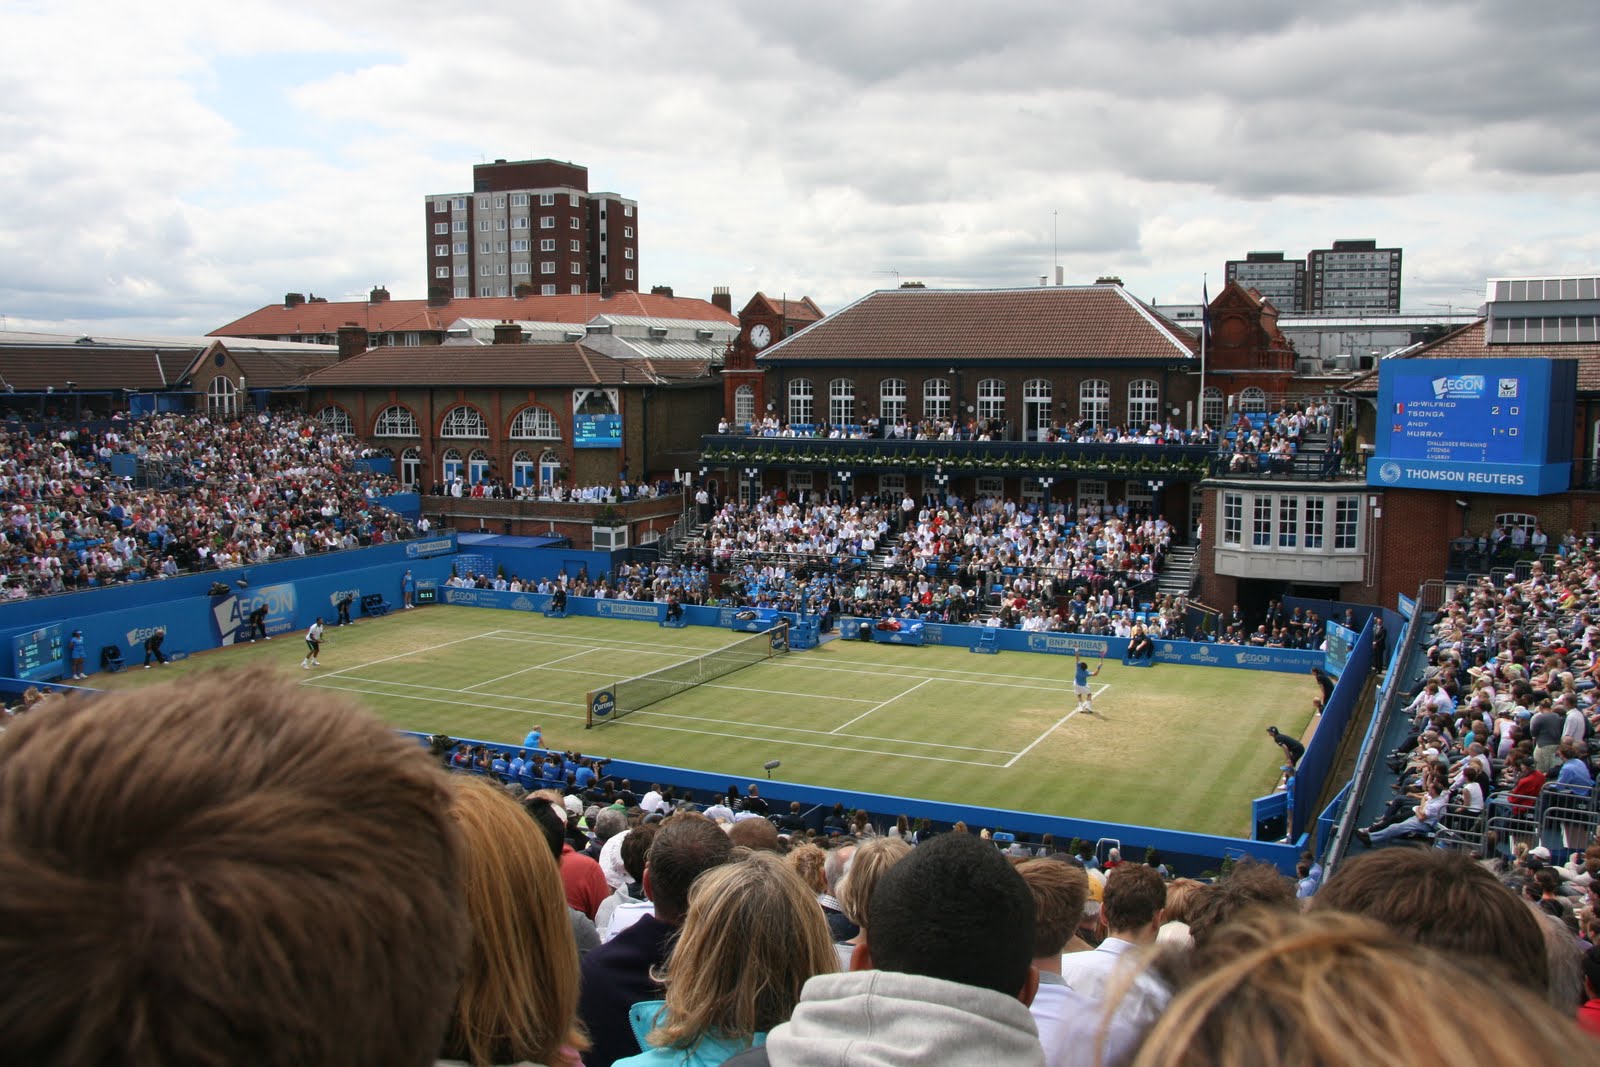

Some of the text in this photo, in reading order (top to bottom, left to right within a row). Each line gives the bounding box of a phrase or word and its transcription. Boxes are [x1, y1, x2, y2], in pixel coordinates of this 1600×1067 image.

[1441, 379, 1483, 390] AEGON
[1407, 410, 1445, 418] TSONGA
[1491, 406, 1499, 415] 2
[1406, 430, 1443, 438] MURRAY
[1492, 427, 1496, 436] 1
[1405, 468, 1524, 485] THOMSON REUTERS
[452, 591, 477, 601] AEGON
[230, 591, 294, 622] AEGON
[613, 604, 655, 615] BNP PARIBAS
[1049, 639, 1103, 650] BNP PARIBAS
[1155, 650, 1183, 661] allplay
[1190, 652, 1219, 664] allplay
[1241, 653, 1270, 664] AEGON
[593, 700, 614, 713] Corona
